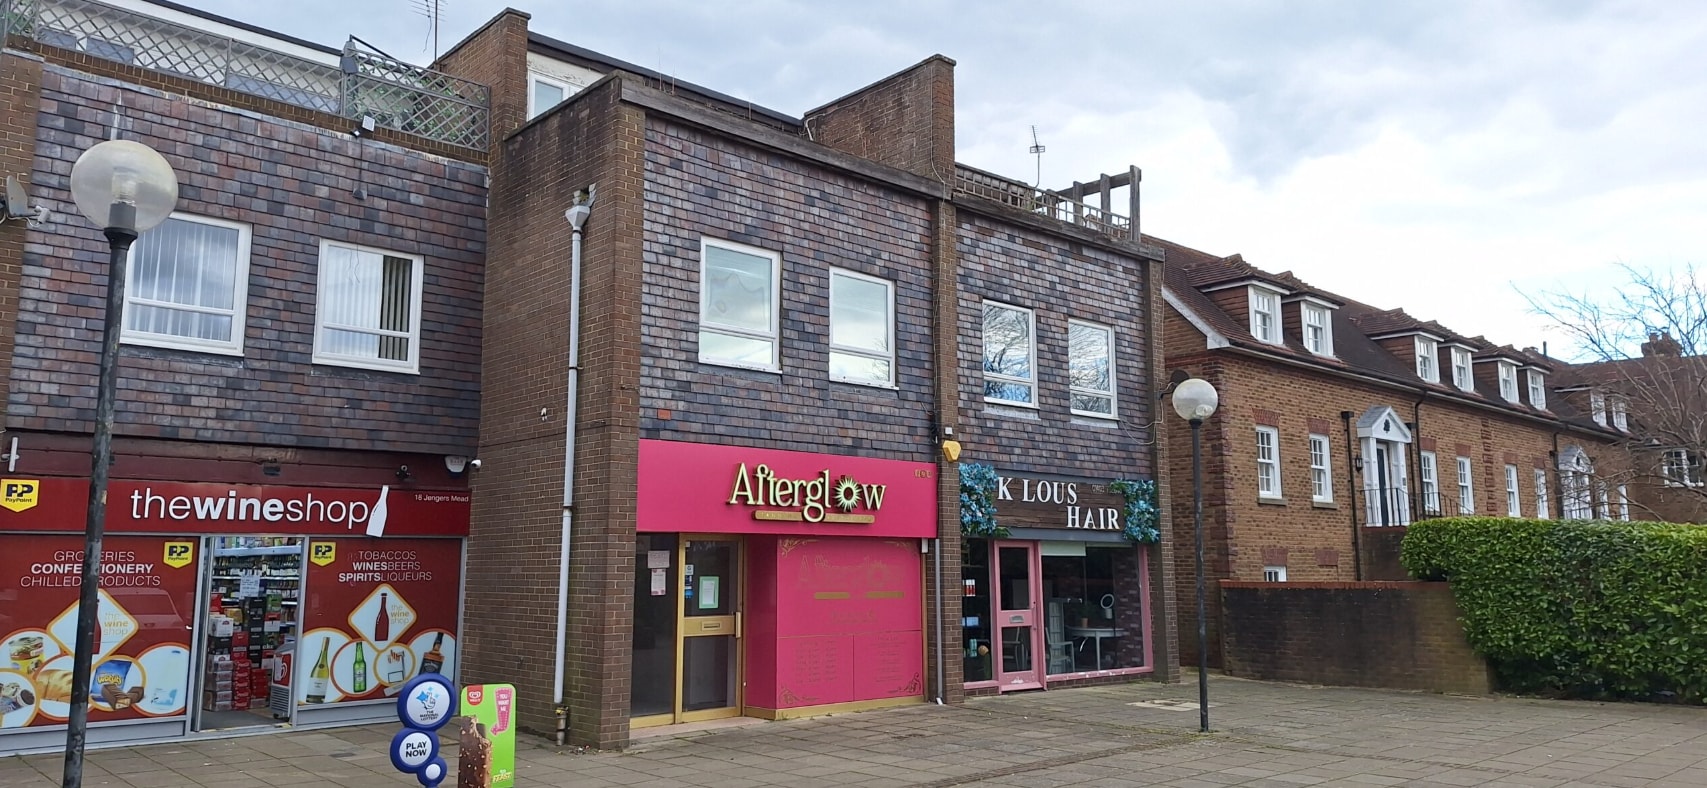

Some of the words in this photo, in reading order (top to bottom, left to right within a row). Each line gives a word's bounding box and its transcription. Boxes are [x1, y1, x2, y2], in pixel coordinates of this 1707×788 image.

[727, 462, 887, 523] Afterglow
[1021, 479, 1078, 505] LOUS
[423, 494, 450, 503] Jengers
[1066, 505, 1120, 530] HAIR
[53, 550, 135, 562] GROERIES
[358, 550, 417, 560] TOBACCOS
[30, 563, 154, 575] CONFEIONERY
[20, 575, 82, 587] CHILLED
[98, 575, 161, 587] RODUCTS
[406, 741, 427, 750] PLAY
[405, 749, 427, 758] NOW
